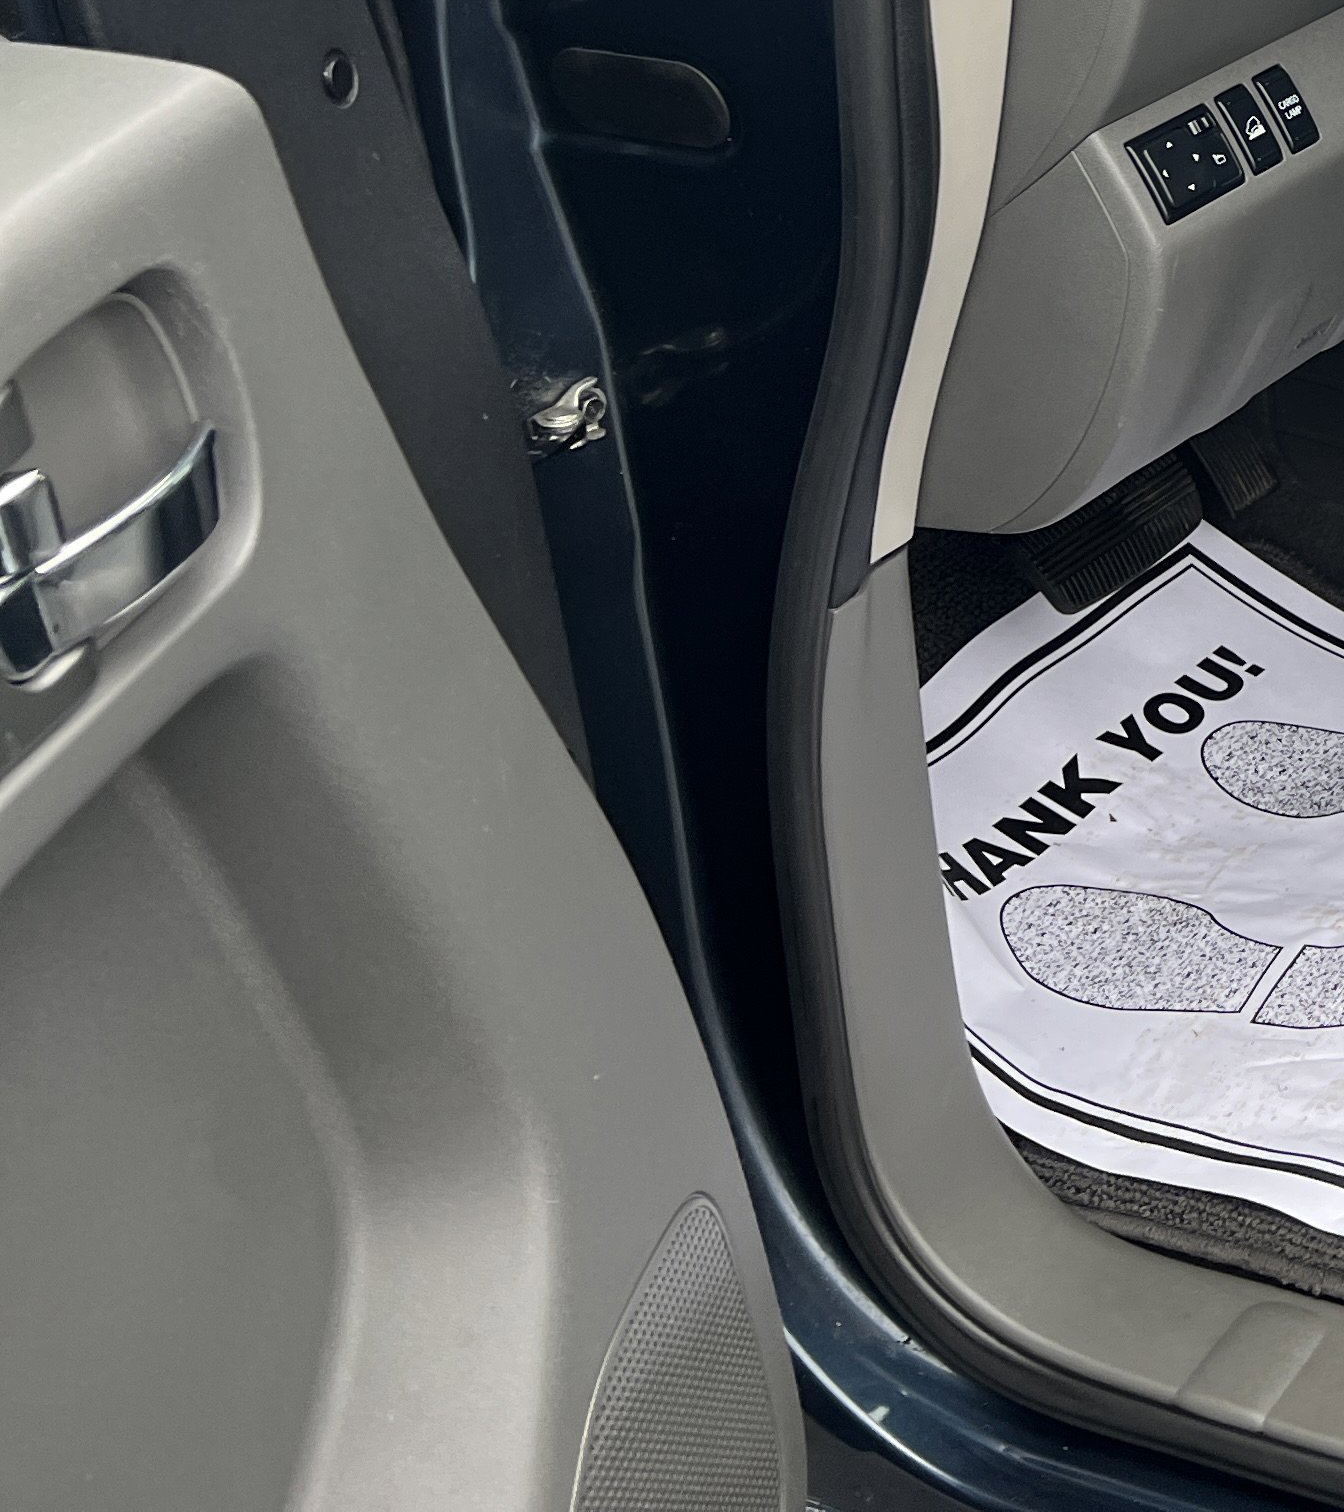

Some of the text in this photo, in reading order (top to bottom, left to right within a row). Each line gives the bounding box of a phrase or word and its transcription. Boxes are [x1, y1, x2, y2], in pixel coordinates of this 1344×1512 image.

[1285, 105, 1302, 120] LAMP
[938, 645, 1266, 901] HANK YOU!
